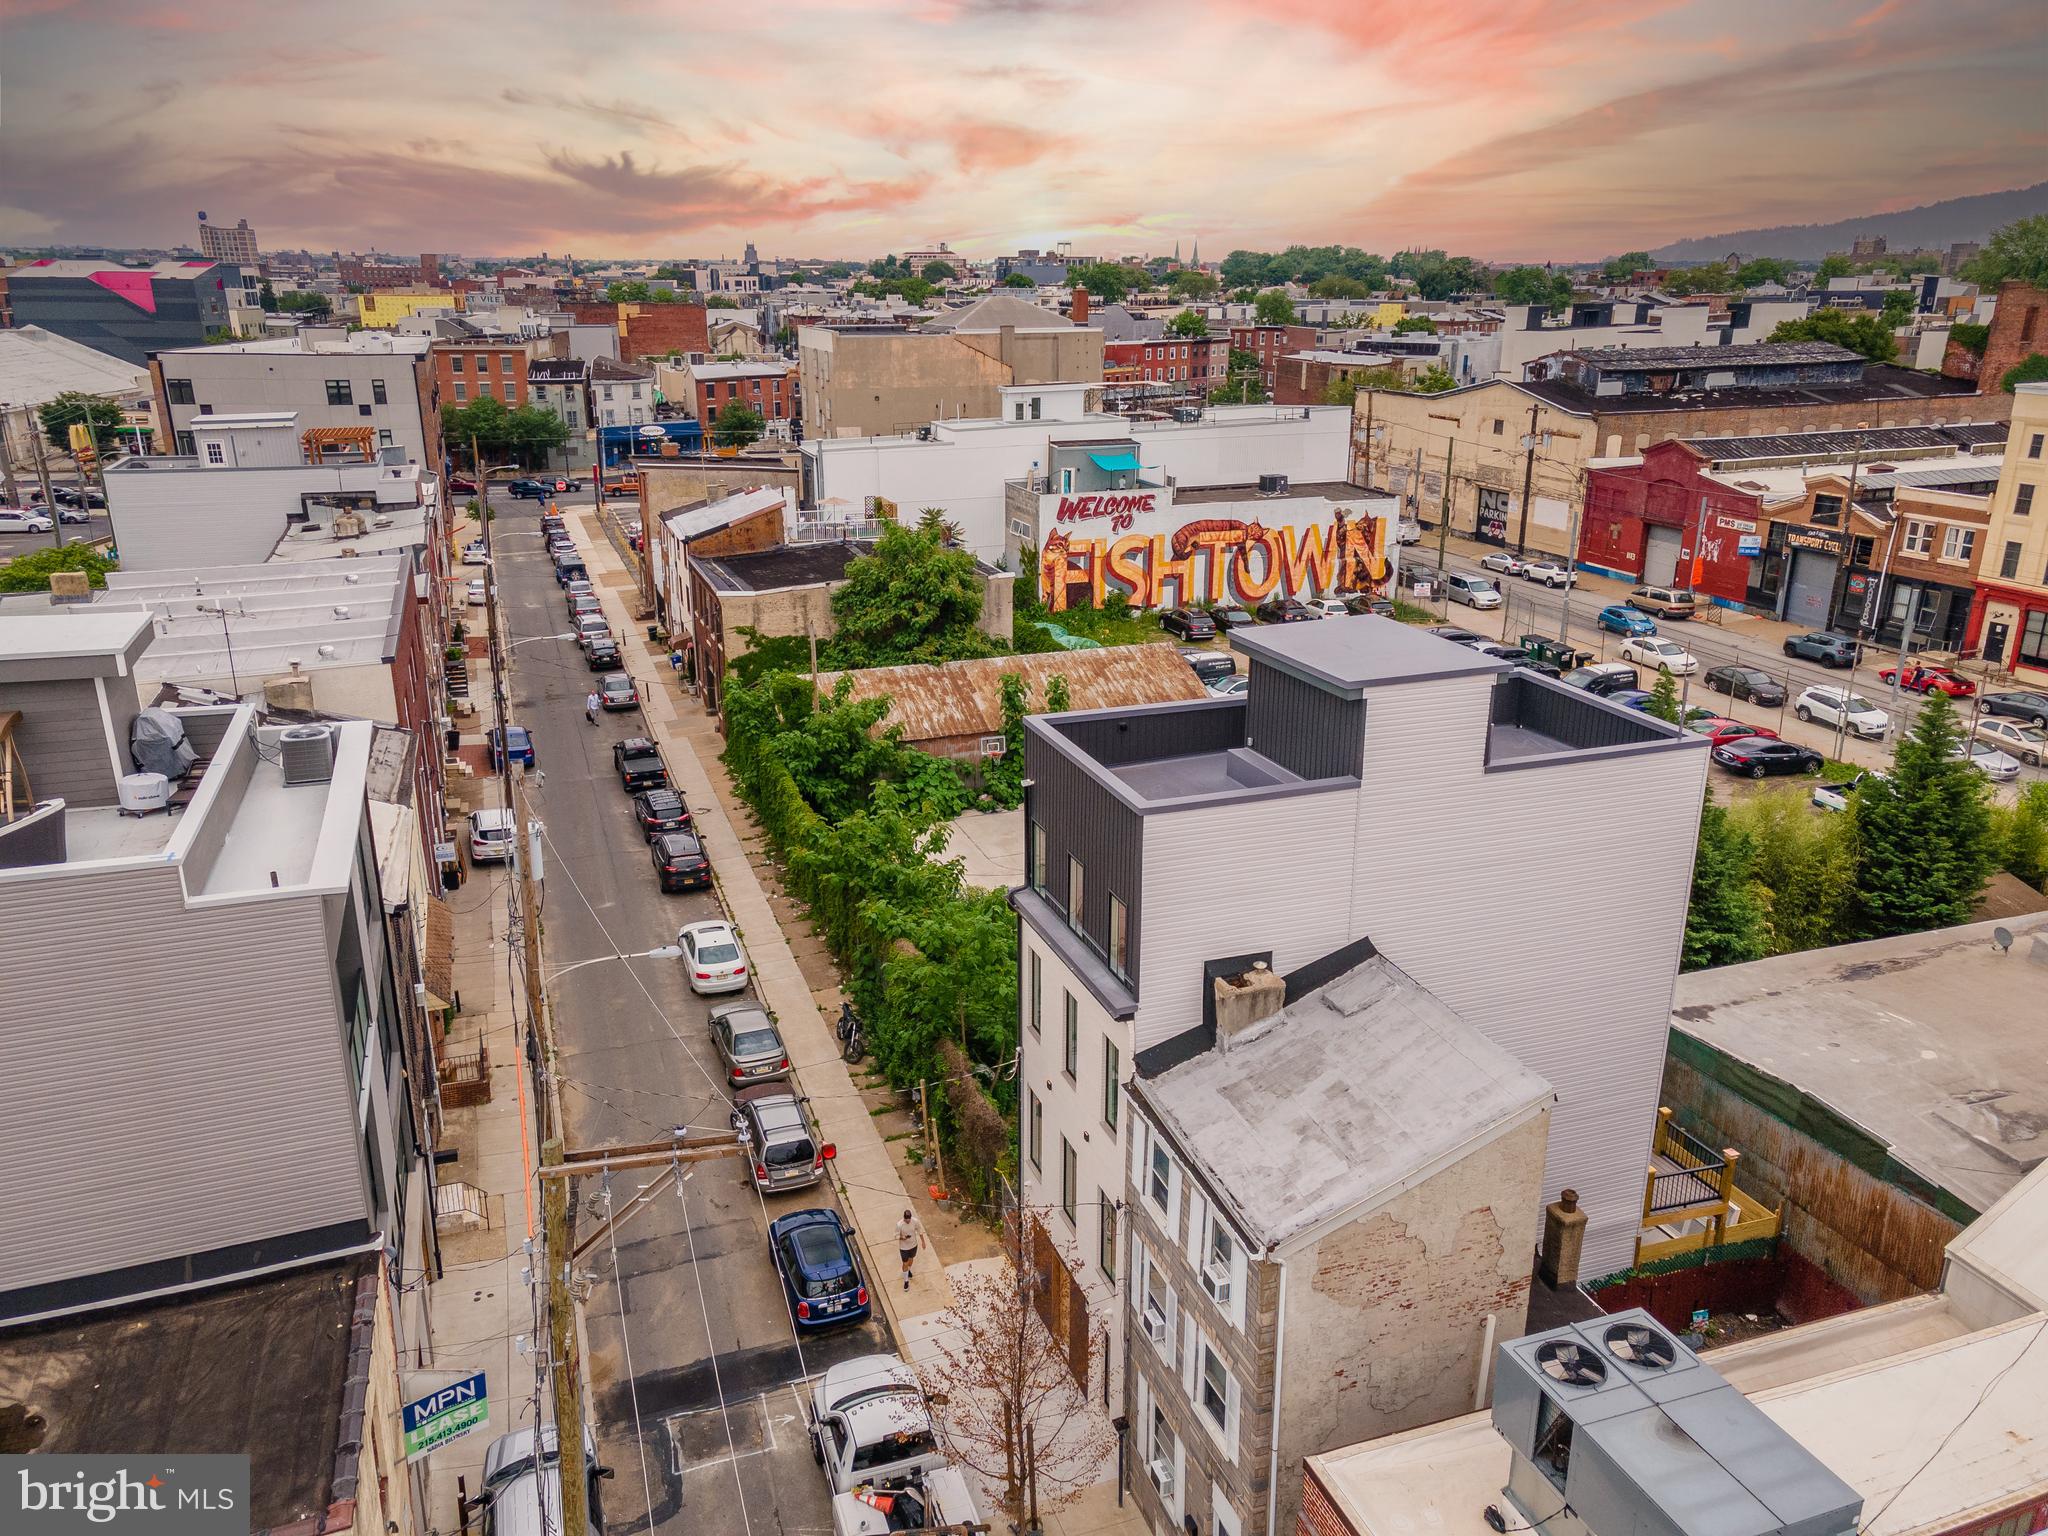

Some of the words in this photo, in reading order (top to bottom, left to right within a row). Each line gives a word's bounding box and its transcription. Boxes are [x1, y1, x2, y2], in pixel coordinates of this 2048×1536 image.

[1056, 494, 1156, 524] WELCOME
[1111, 513, 1136, 535] TO
[1480, 506, 1507, 520] PARKIN
[1041, 512, 1393, 613] FISHTOWN
[414, 1380, 476, 1421] MPN
[410, 1401, 484, 1444] LEASE
[417, 1416, 479, 1450] 215.413.4900
